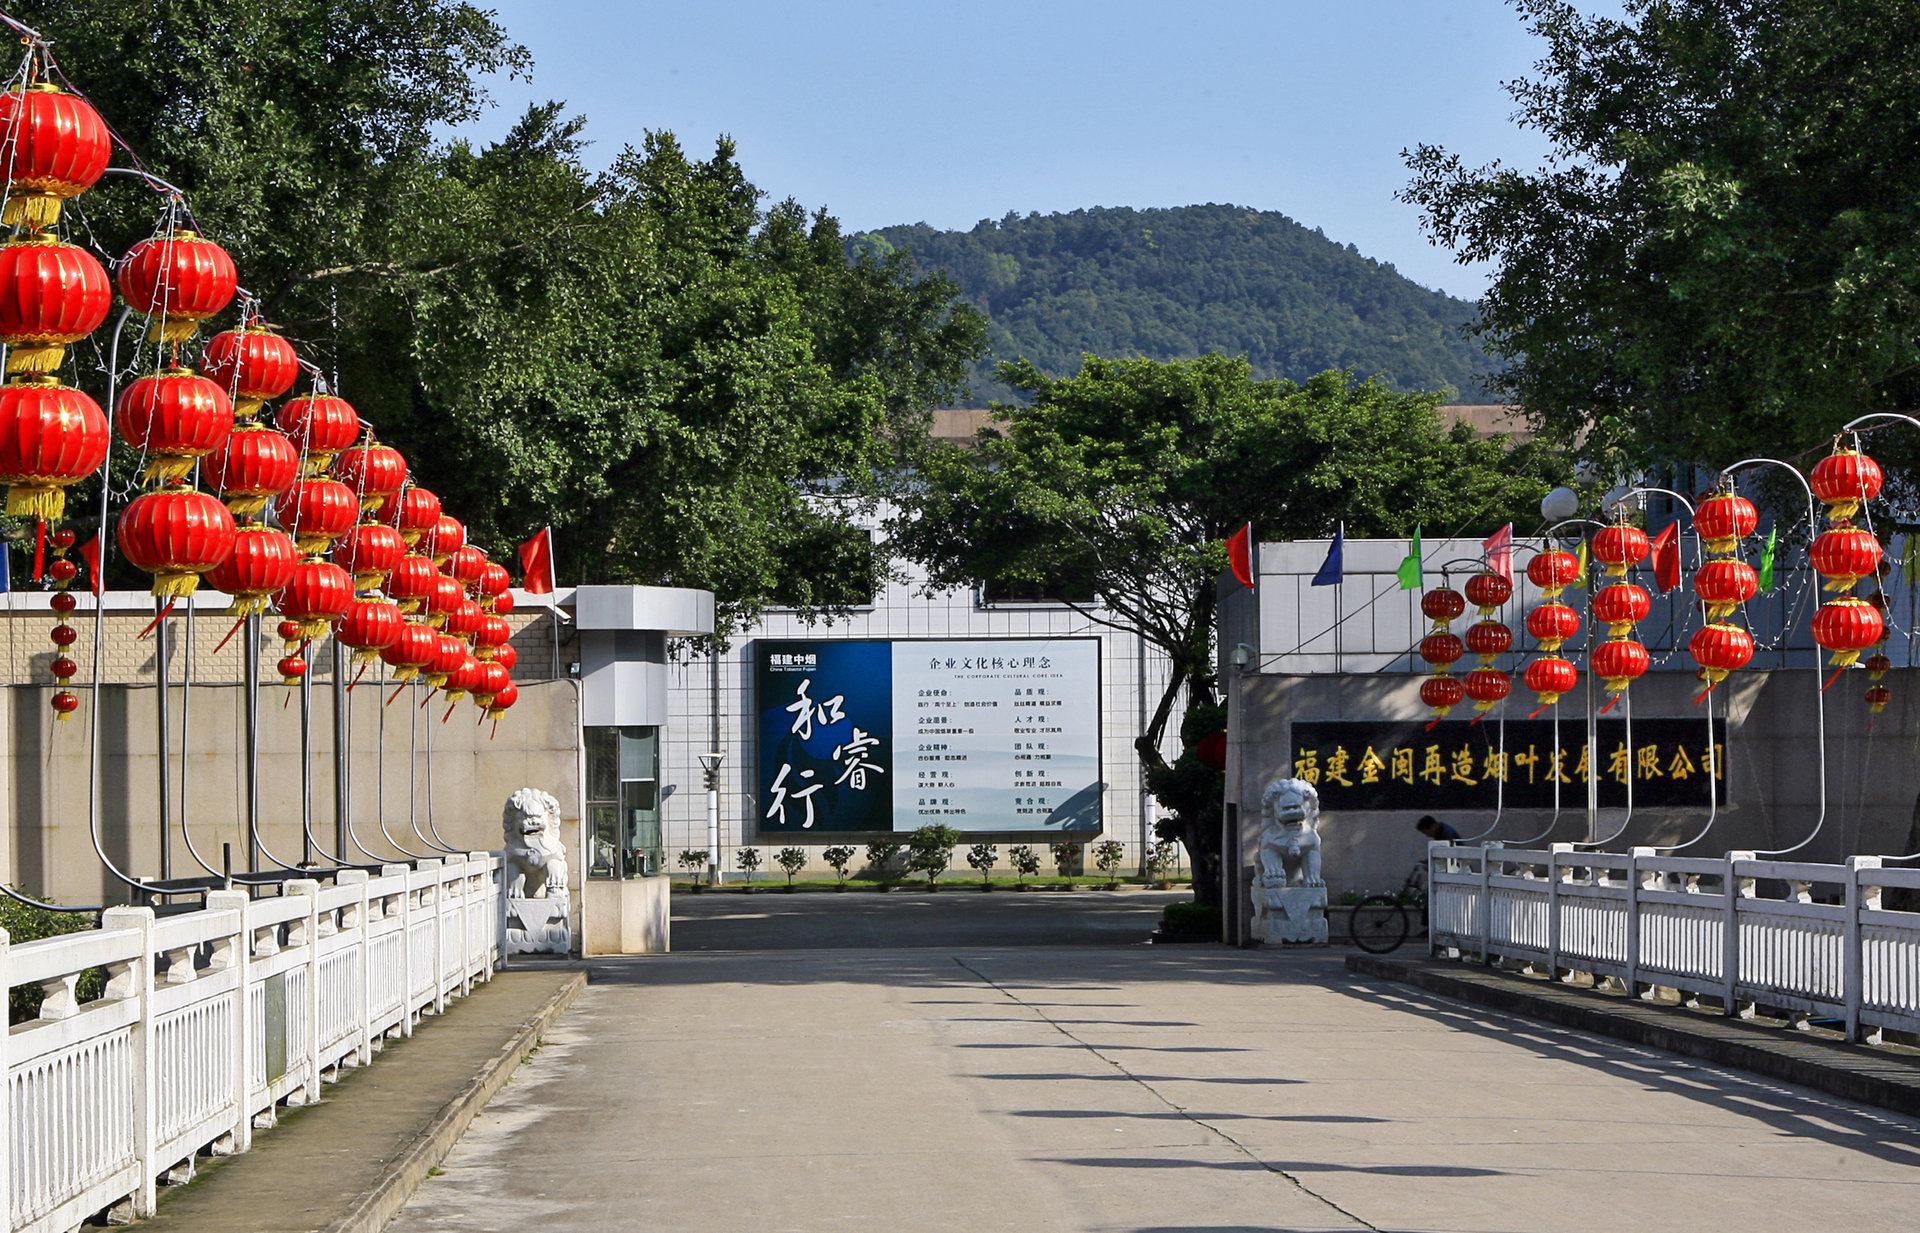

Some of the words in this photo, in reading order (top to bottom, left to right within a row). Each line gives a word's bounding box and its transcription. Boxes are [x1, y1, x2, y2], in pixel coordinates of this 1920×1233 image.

[770, 653, 816, 665] 福建中烟
[930, 656, 1051, 669] 企业文化核心理念
[1295, 742, 1723, 786] 福建金闽再造烟叶发展有限公司
